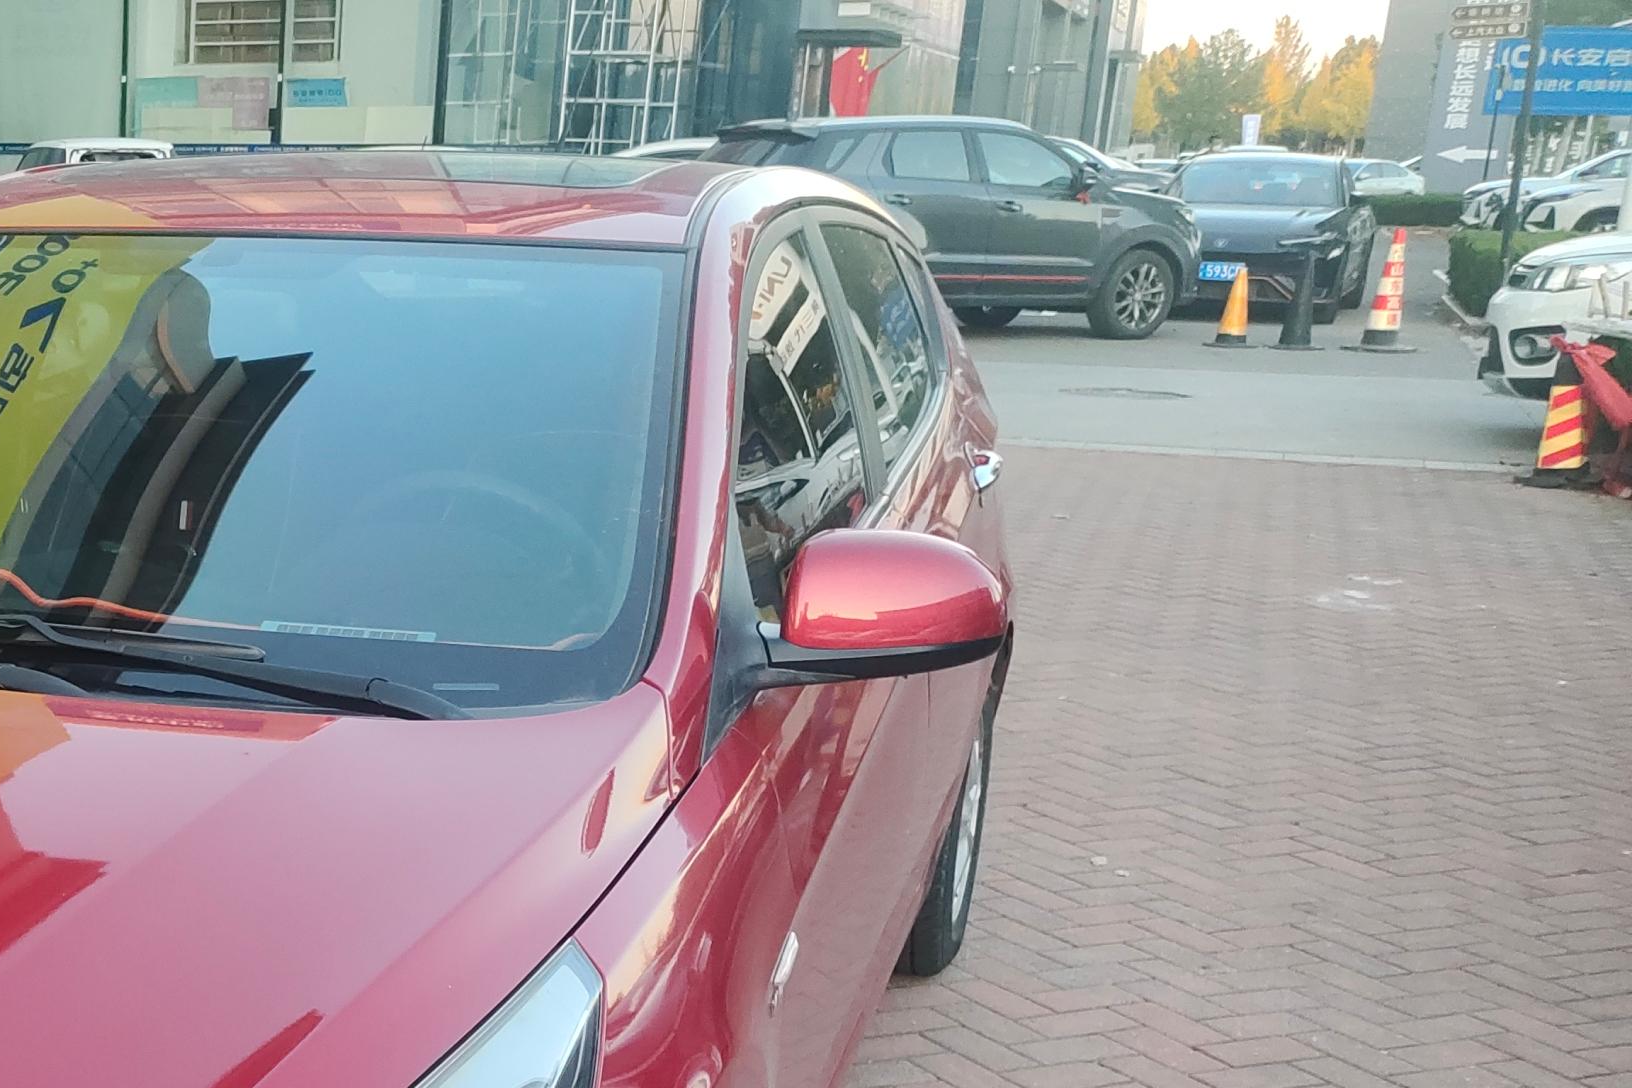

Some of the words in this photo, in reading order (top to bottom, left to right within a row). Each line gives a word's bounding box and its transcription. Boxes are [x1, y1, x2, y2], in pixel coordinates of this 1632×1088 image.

[1444, 40, 1481, 129] 想长远发展
